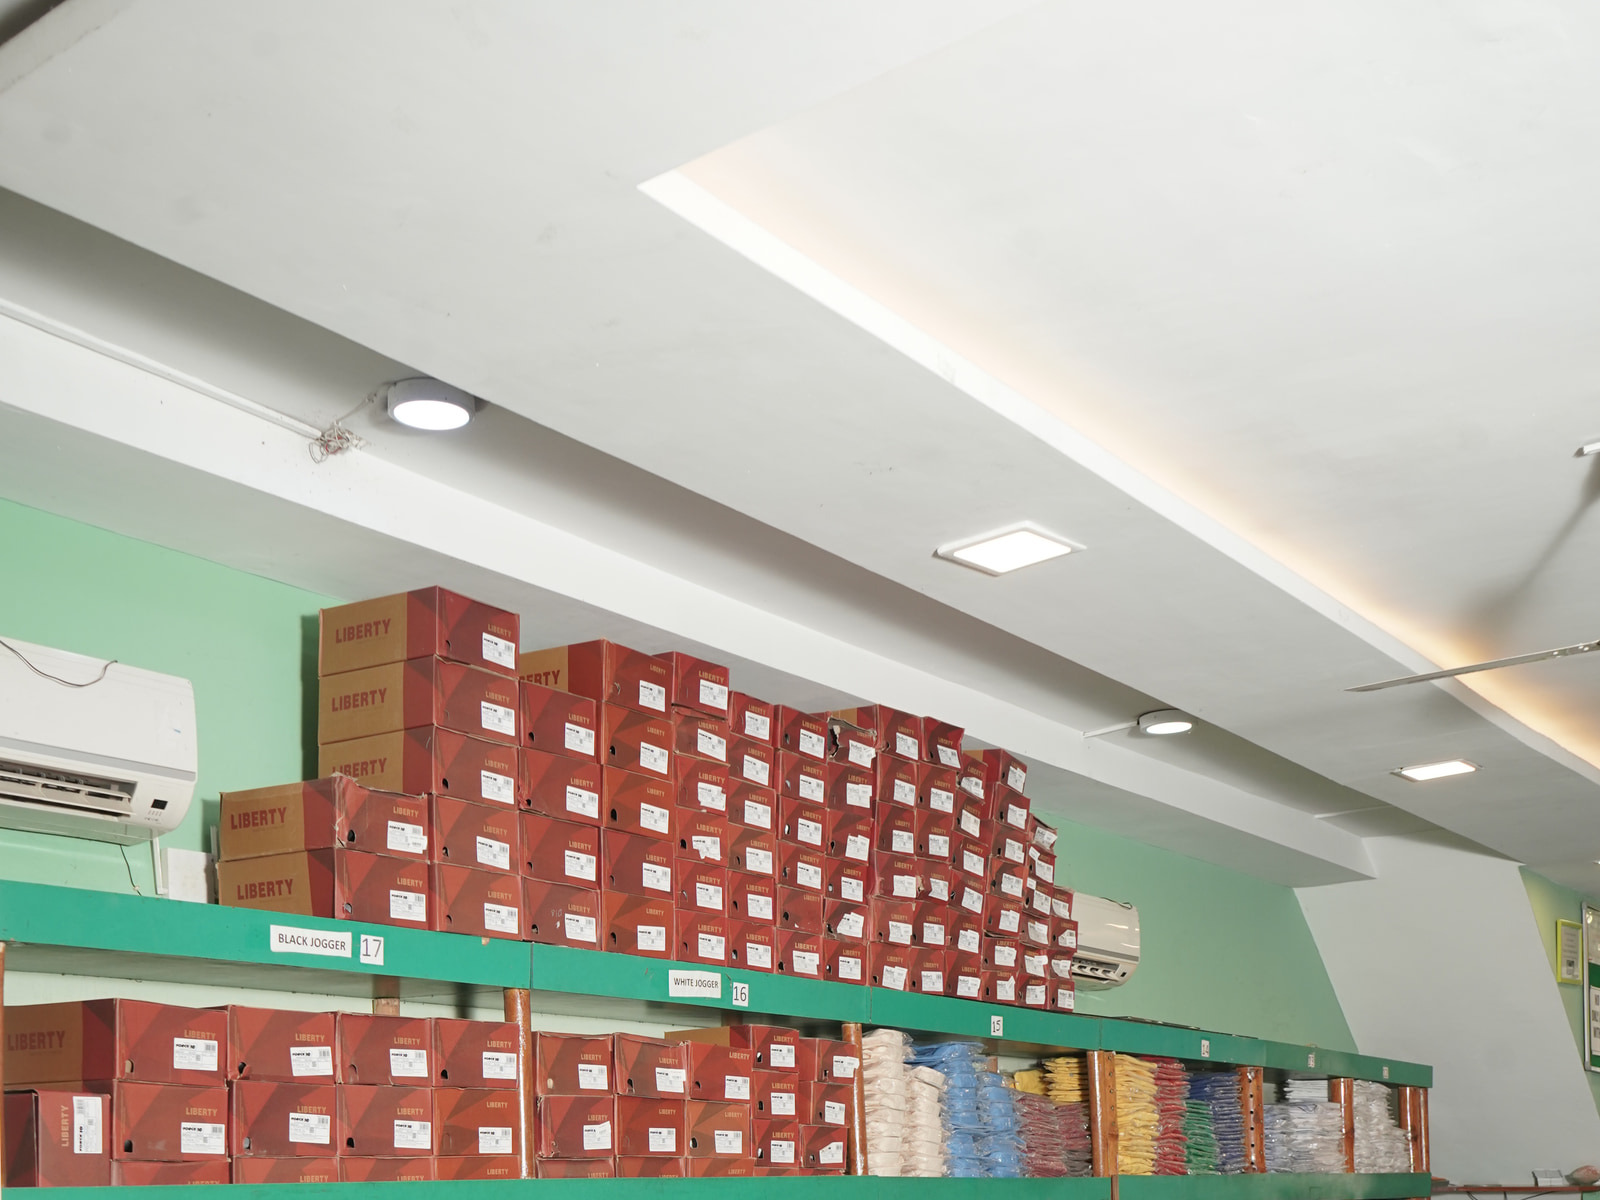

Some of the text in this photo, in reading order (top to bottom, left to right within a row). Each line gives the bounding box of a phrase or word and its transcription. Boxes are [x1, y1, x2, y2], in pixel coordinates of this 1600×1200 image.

[336, 619, 390, 643] LIBERTY
[332, 688, 386, 712] LIBERTY
[698, 772, 725, 784] LIBERTY
[231, 808, 286, 830] LIBERTY
[696, 823, 722, 835] LIBERTY
[238, 879, 292, 900] LIBERTY
[278, 934, 346, 952] BLACK JOGGER
[362, 938, 381, 958] 17
[674, 977, 719, 990] WHITE JOGGER
[733, 986, 747, 1002] 16
[993, 1020, 1000, 1032] 15
[8, 1031, 65, 1050] LIBERTY
[184, 1030, 215, 1040] LIBERTY
[296, 1033, 325, 1041] LIBERTY
[186, 1107, 217, 1116] LIBERTY
